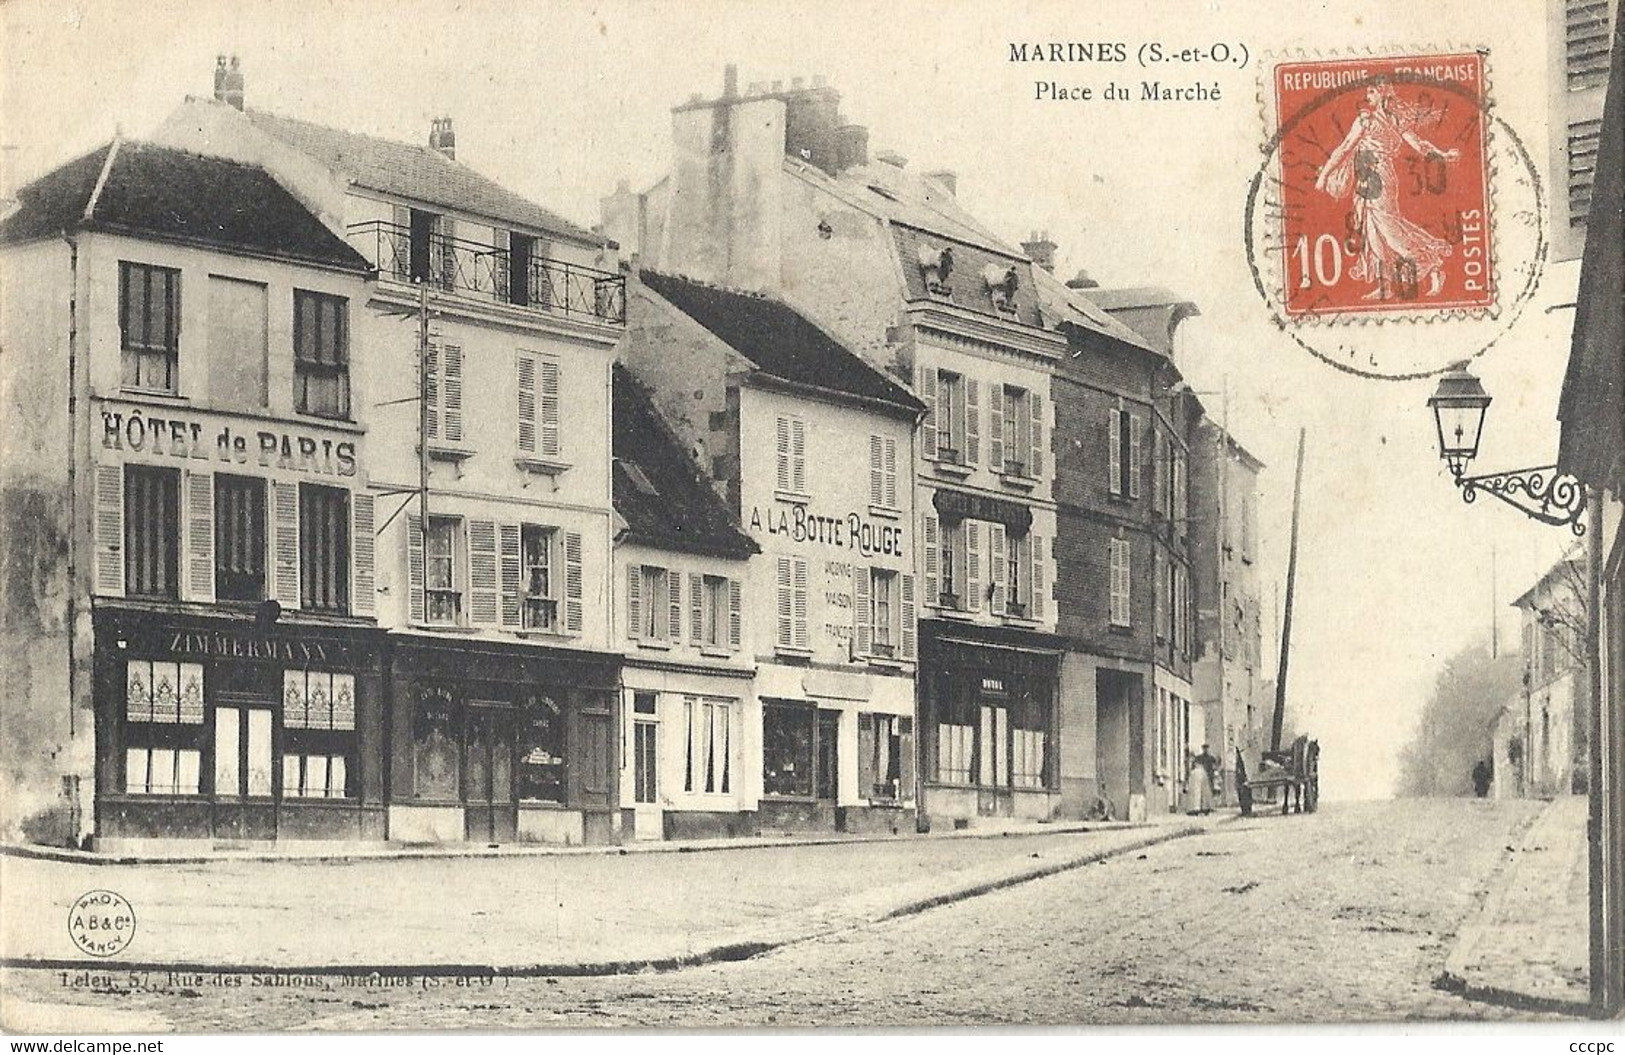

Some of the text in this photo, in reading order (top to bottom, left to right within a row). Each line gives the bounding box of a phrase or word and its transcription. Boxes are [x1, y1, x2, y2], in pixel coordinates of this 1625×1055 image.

[1462, 208, 1483, 292] POSTES
[101, 409, 357, 478] HÔTEL de PARIS
[751, 506, 762, 532] A
[768, 508, 789, 537] LA
[170, 633, 327, 662] ZIMMERMANN
[79, 934, 122, 952] NANCY
